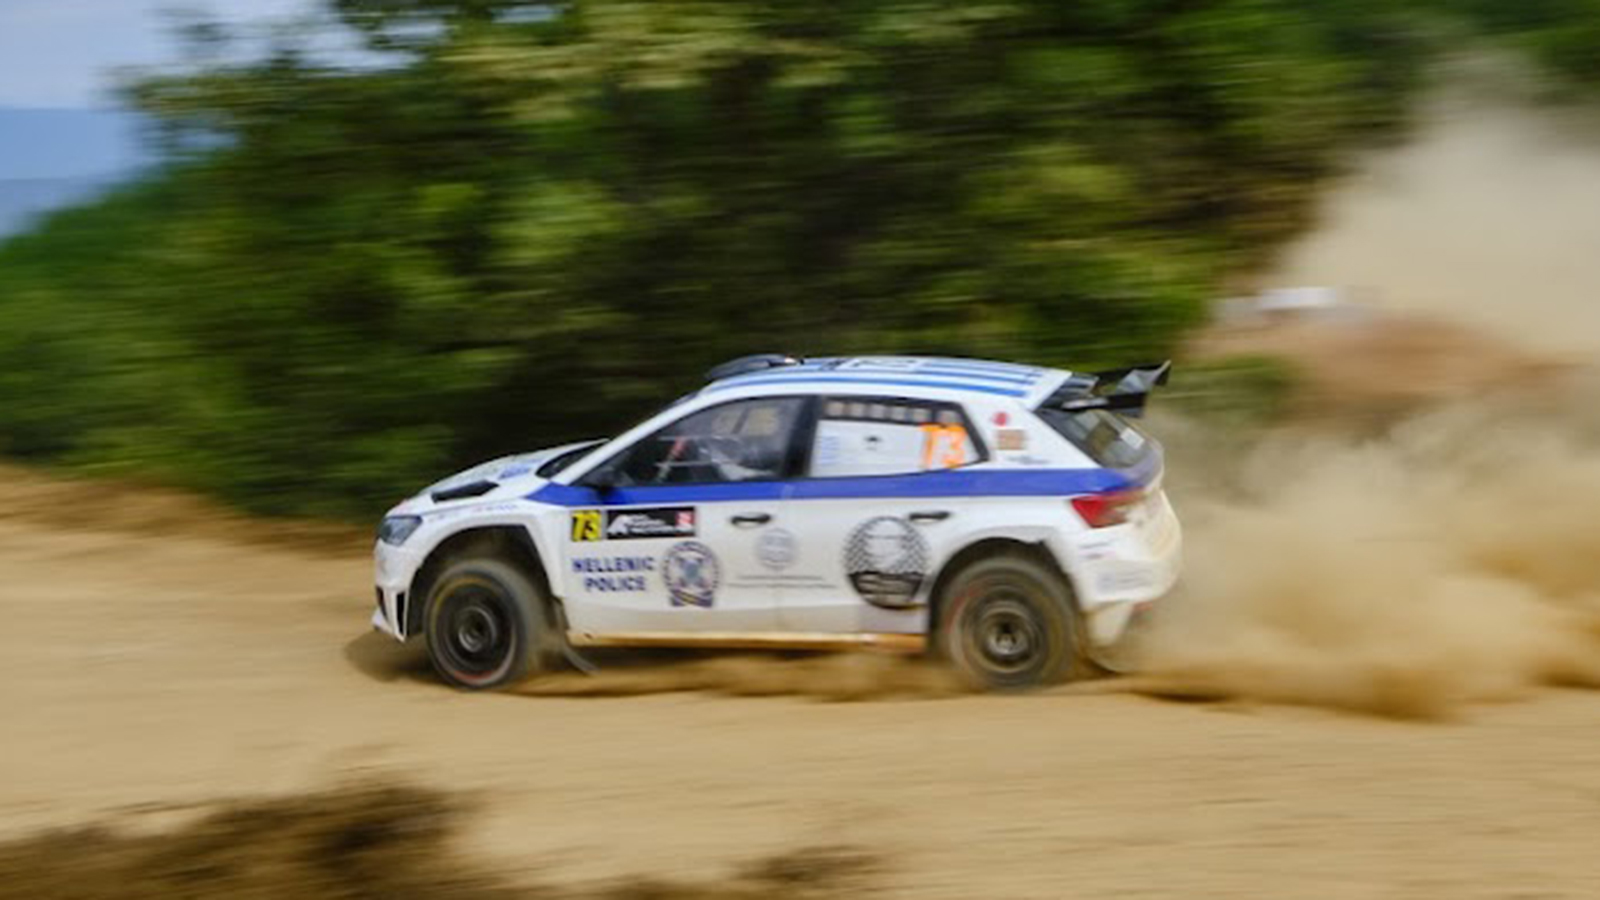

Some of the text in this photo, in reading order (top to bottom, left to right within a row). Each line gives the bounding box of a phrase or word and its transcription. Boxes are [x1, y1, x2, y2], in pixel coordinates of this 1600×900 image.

[920, 423, 968, 469] 73
[572, 511, 600, 541] 73
[571, 556, 655, 573] HELLENIC
[584, 576, 646, 593] POLICE
